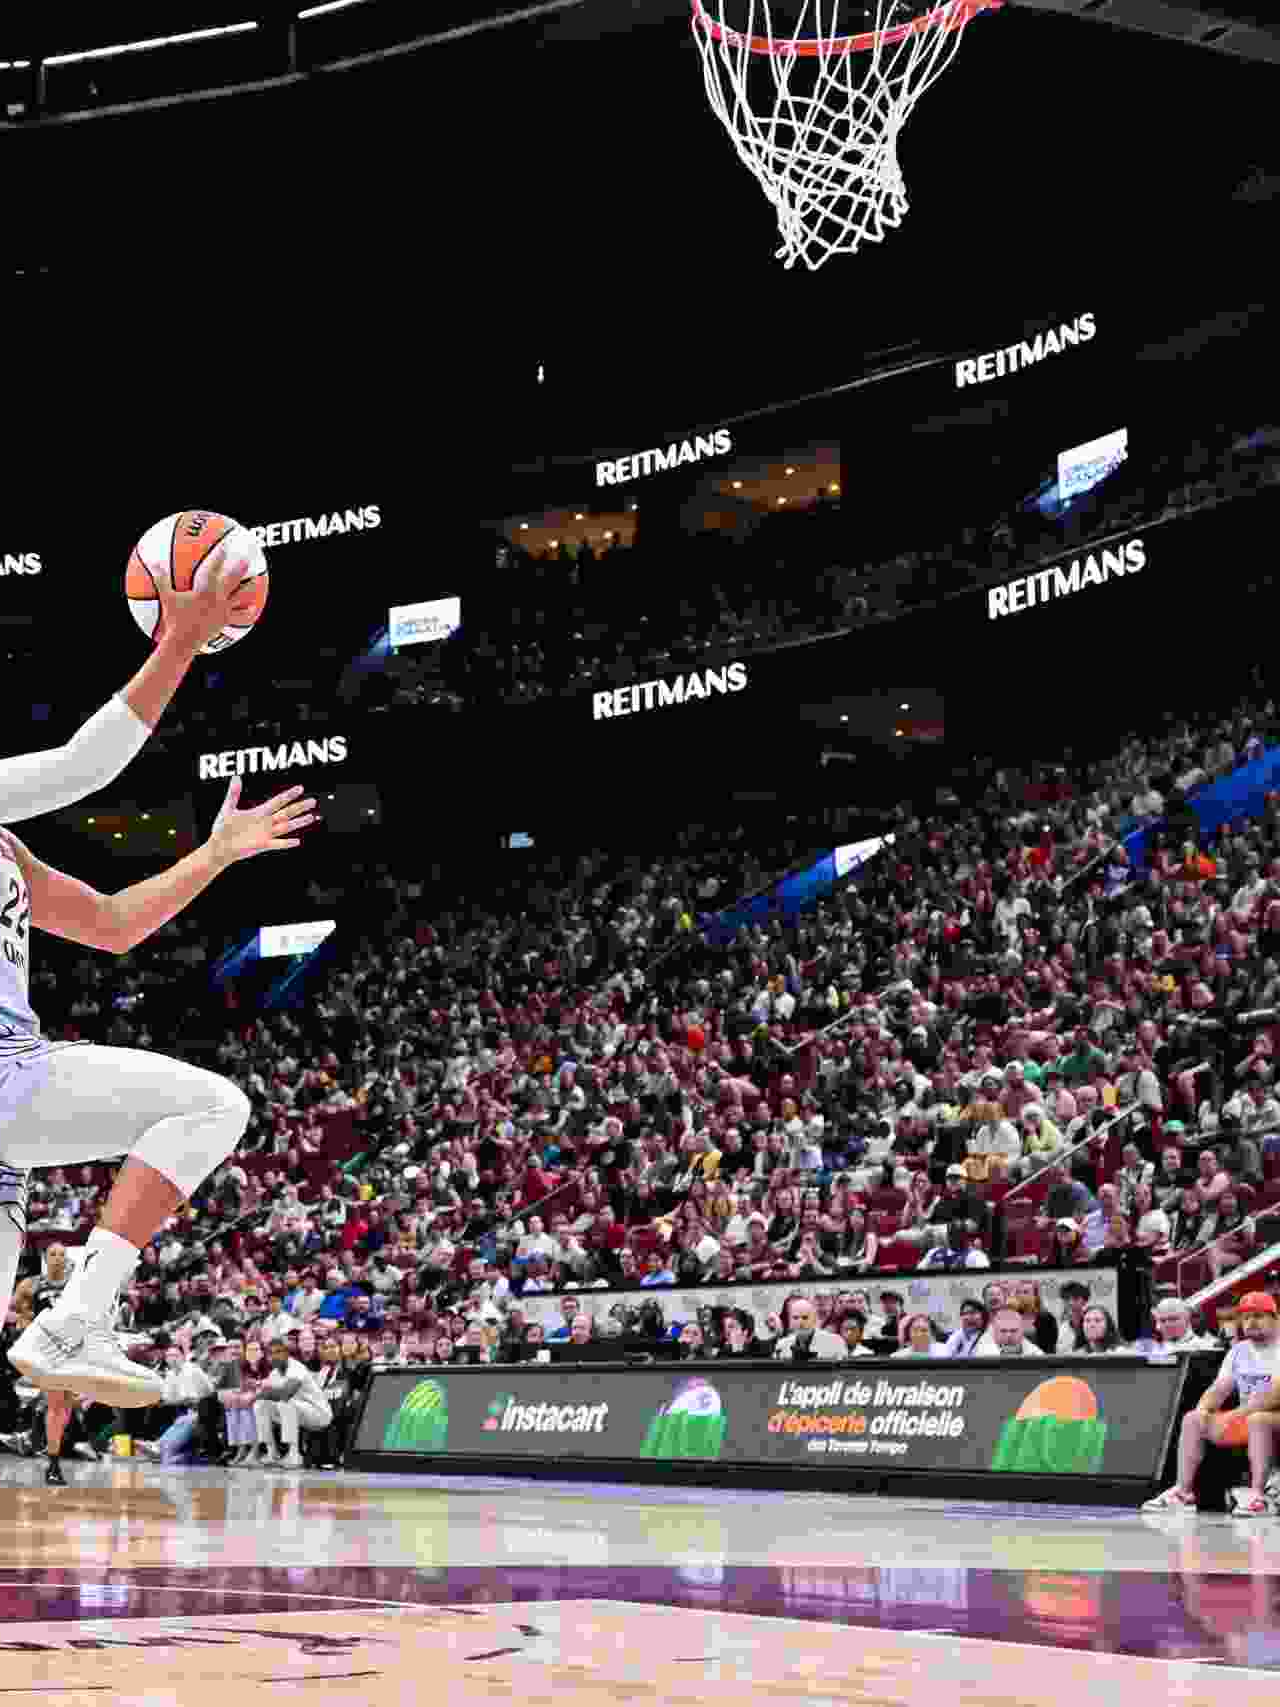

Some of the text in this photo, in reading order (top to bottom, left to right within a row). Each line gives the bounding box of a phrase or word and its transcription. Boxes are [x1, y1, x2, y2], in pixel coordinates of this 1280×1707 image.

[955, 312, 1097, 388] REITMANS
[596, 429, 732, 487] REITMANS
[252, 505, 381, 549] REITMANS
[988, 539, 1146, 620] REITMANS
[593, 662, 748, 721] REITMANS
[199, 735, 348, 780] REITMANS
[499, 1394, 609, 1433] instacart
[777, 1380, 965, 1408] L'appli de livraison
